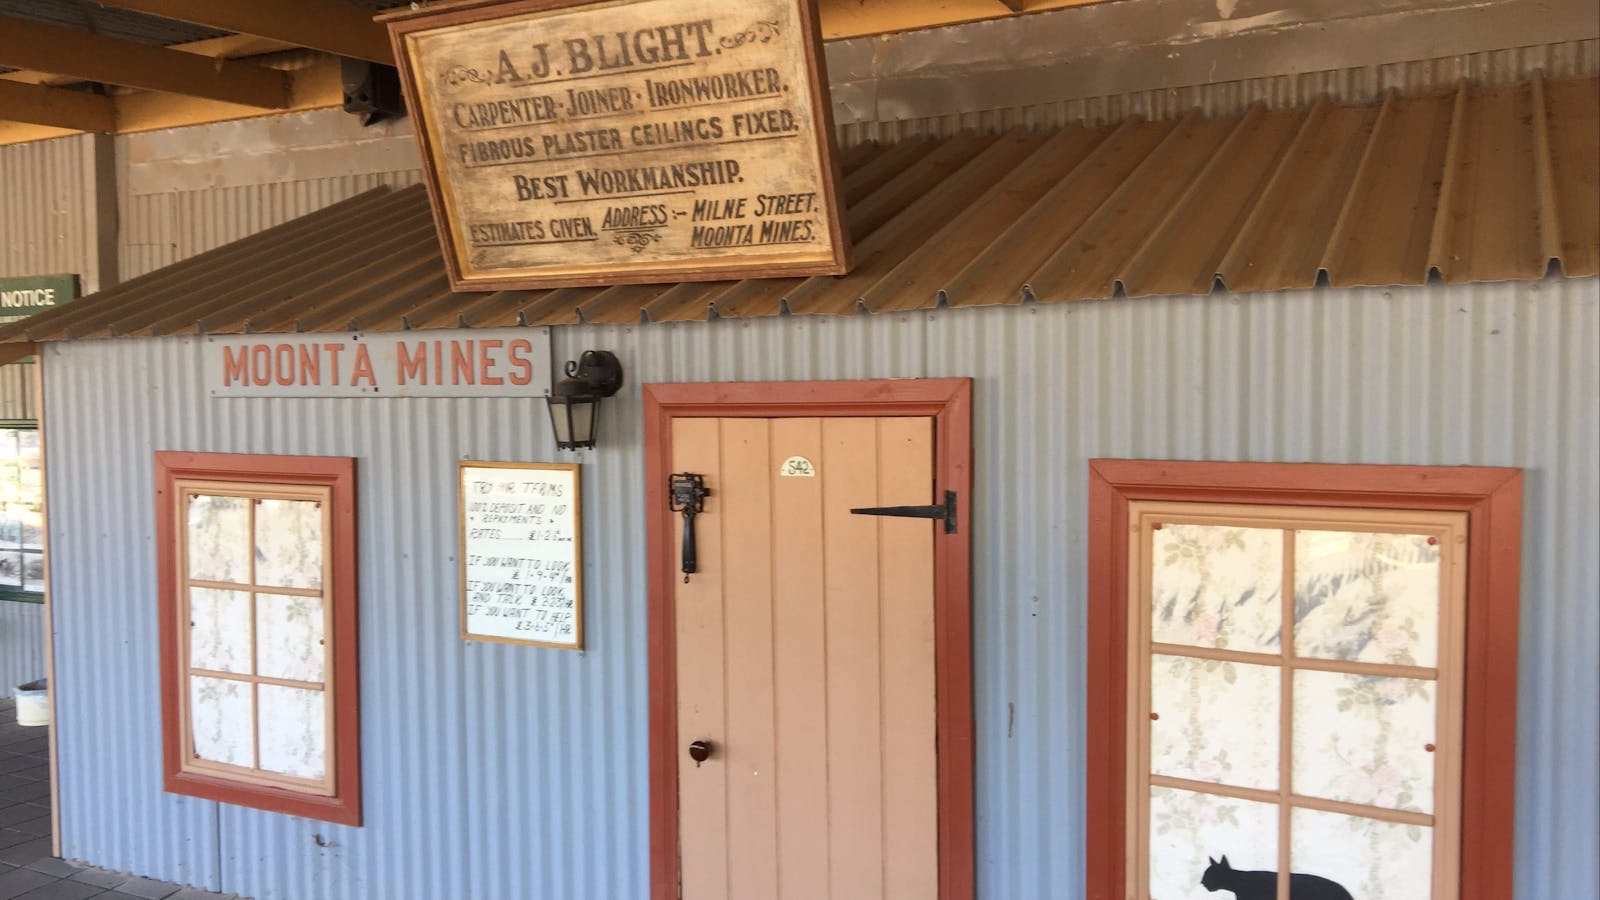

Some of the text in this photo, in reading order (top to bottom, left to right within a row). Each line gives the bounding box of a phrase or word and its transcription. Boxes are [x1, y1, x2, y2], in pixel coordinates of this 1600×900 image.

[564, 18, 722, 75] BLIGHT.
[453, 67, 790, 129] CARPENTER JOINER IRONWORKER.
[458, 108, 800, 164] FIBROUS PLASTER CEILINGS FIXED.
[512, 159, 745, 202] BEST WORKMANSHIP.
[690, 197, 748, 223] MILNE
[753, 191, 819, 218] STREET.
[469, 216, 598, 243] ESTIMATES GIVEN.
[690, 219, 816, 248] MOONTA MINES.
[0, 288, 56, 308] NOTICE
[222, 338, 533, 388] MOONTA MINES
[788, 459, 811, 476] 542
